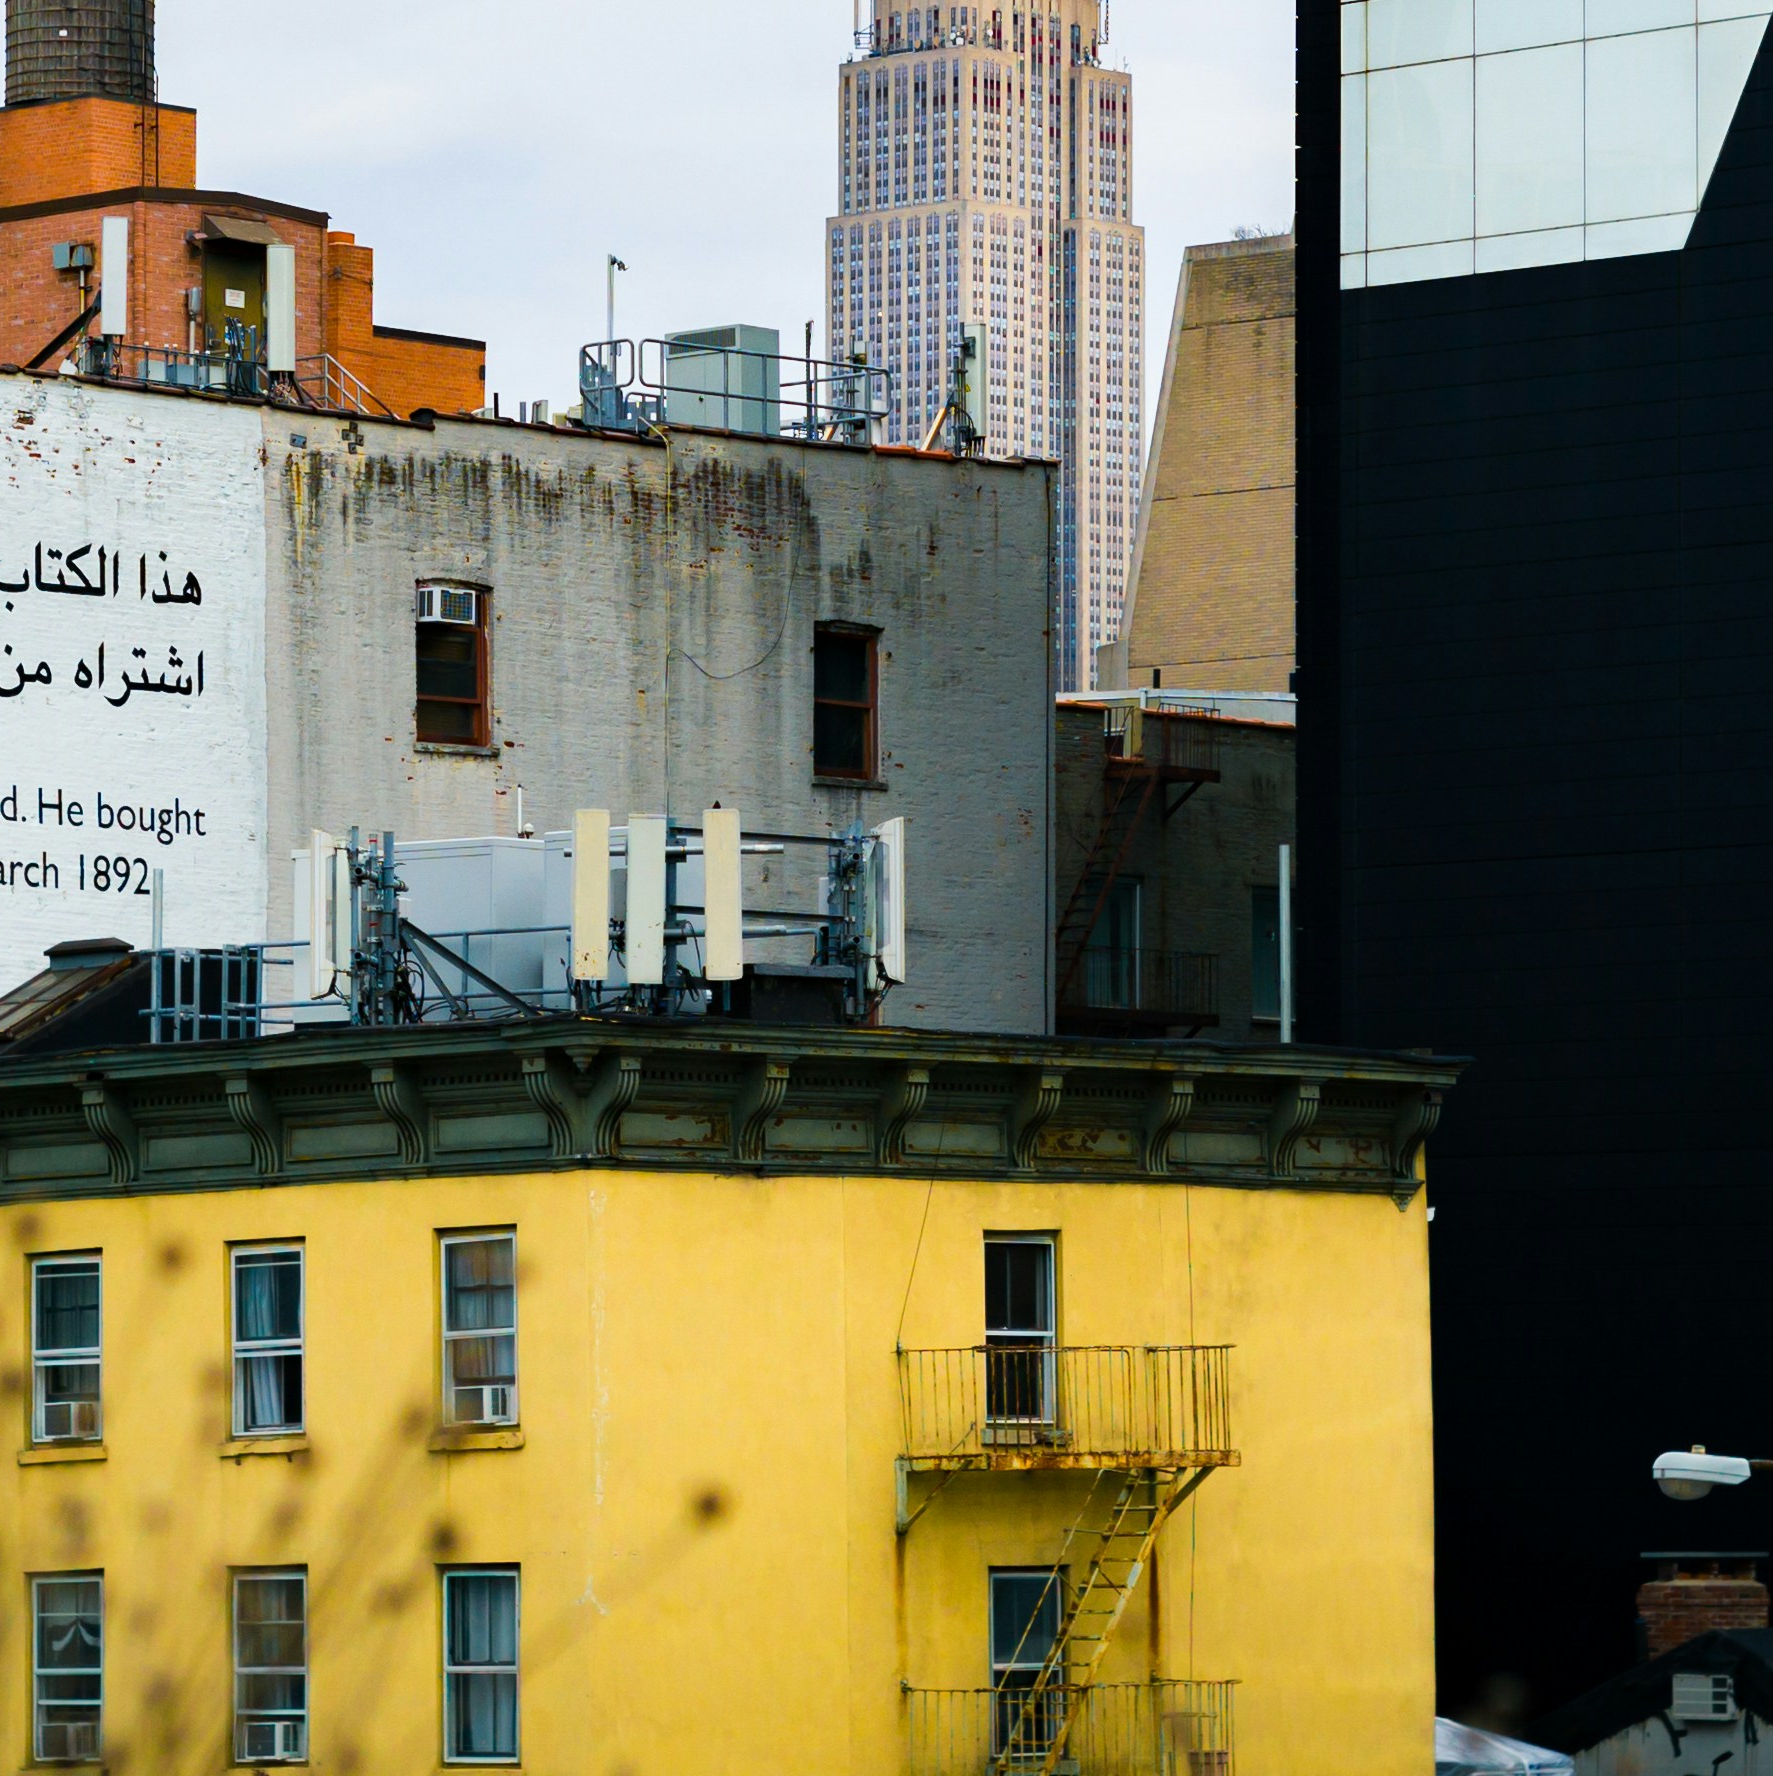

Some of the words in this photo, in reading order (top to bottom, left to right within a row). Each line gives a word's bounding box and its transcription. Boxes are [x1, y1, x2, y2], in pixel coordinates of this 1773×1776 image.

[139, 550, 202, 606] هذا
[74, 641, 204, 708] اشتراه
[38, 787, 84, 827] He
[97, 791, 207, 846] bought
[79, 853, 151, 895] 1892
